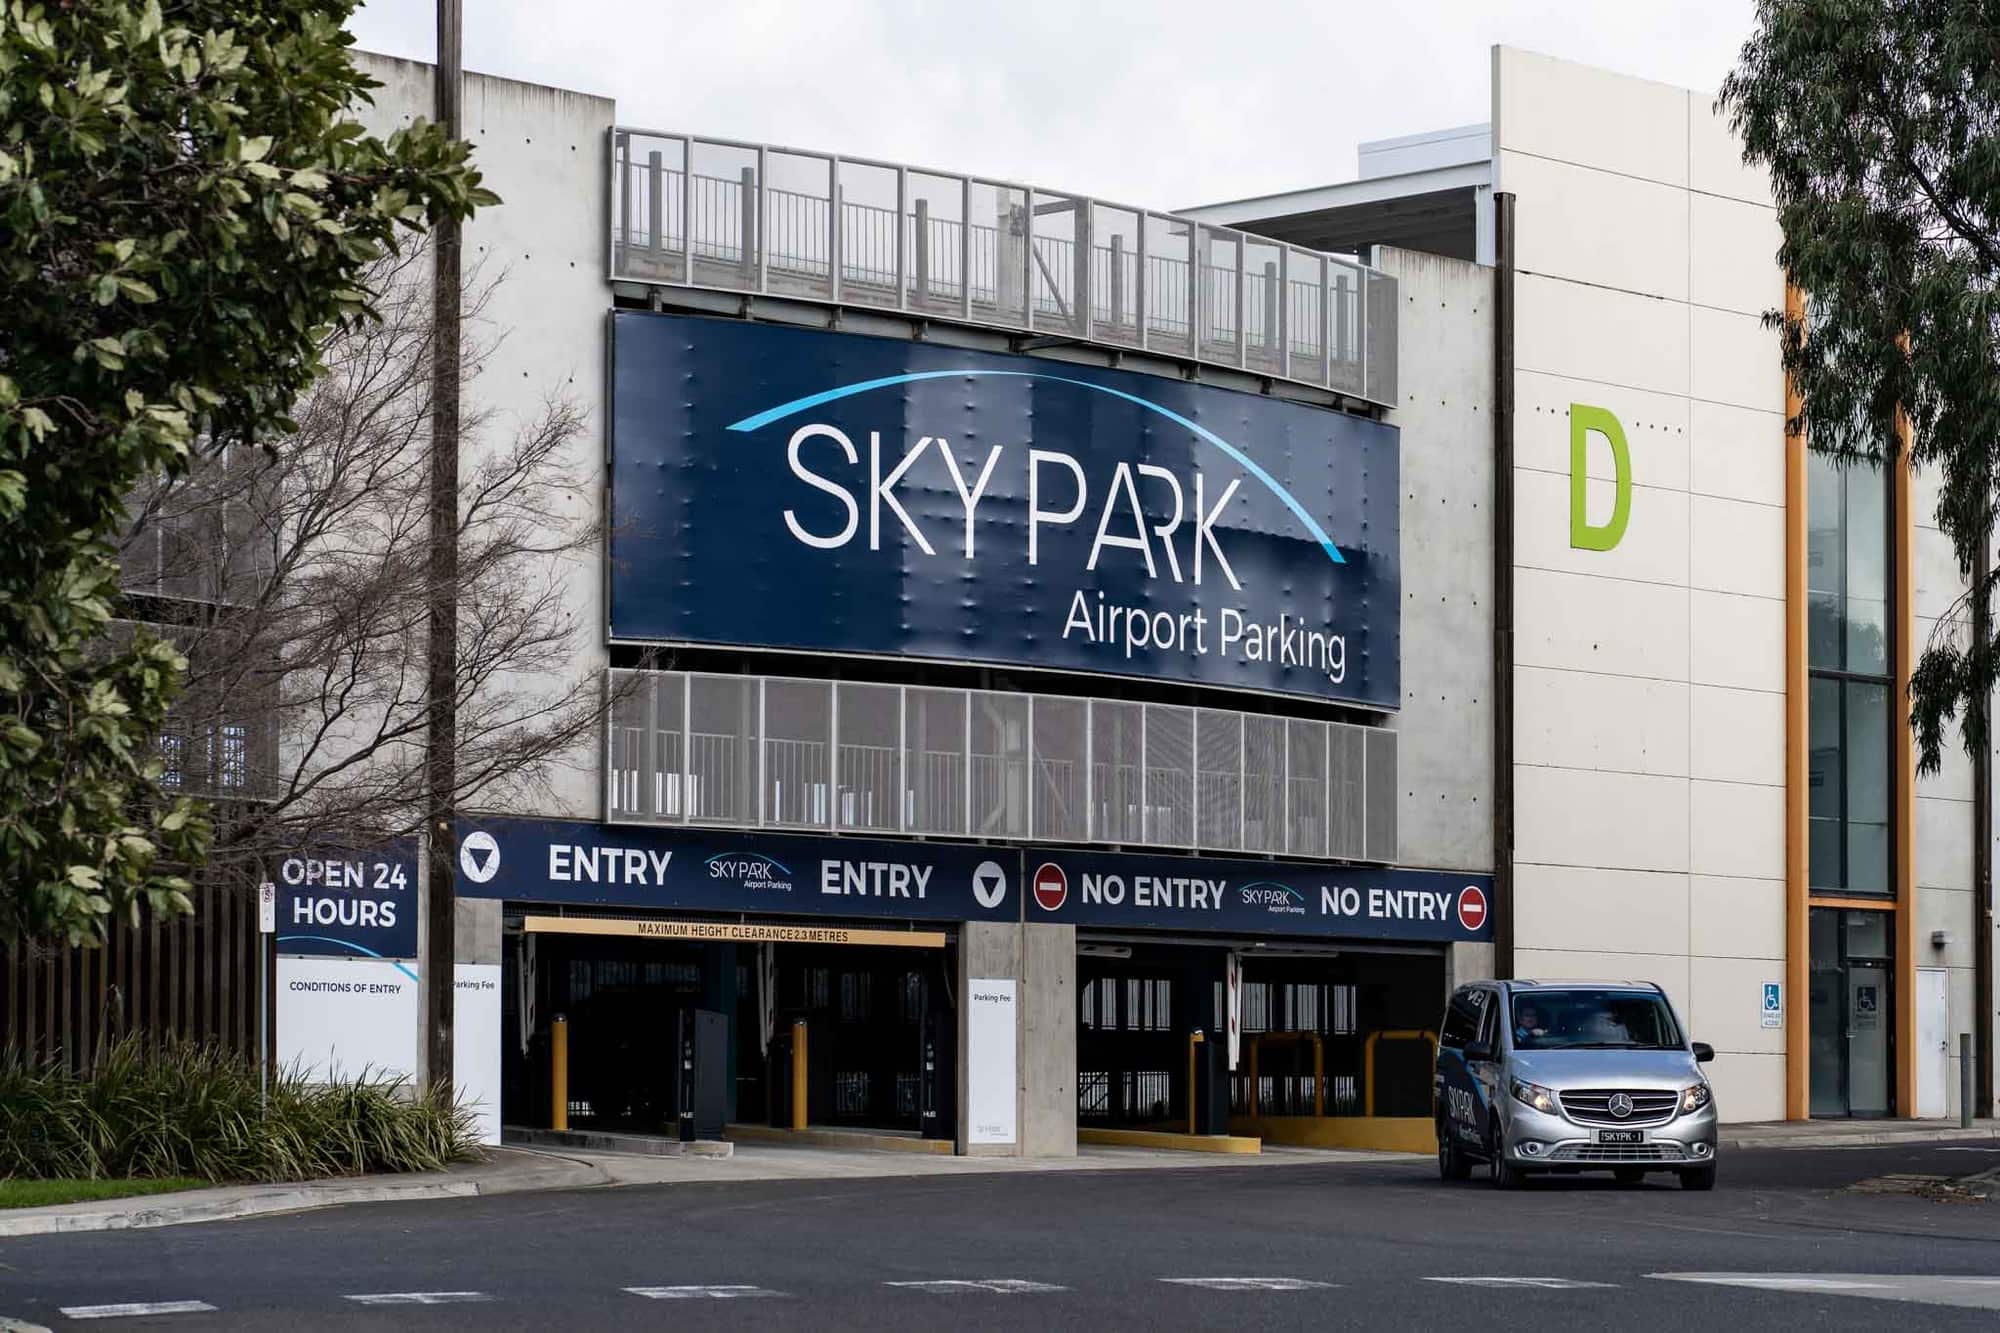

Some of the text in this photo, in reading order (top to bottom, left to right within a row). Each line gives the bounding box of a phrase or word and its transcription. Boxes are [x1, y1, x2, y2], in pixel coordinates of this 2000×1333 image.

[1570, 403, 1632, 552] D
[1062, 590, 1347, 685] Airport Parking
[282, 858, 407, 890] OPEN 24
[548, 844, 673, 887] ENTRY
[820, 859, 934, 899] ENTRY
[743, 880, 792, 892] Airport Parking
[1081, 873, 1227, 910] NO ENTRY
[293, 897, 396, 927] HOURS
[1320, 886, 1452, 922] NO ENTRY
[638, 923, 688, 936] MAXIMUM
[691, 926, 728, 938] HEIGHT
[731, 928, 793, 940] CLEARANCE
[808, 930, 849, 942] METRES
[289, 981, 401, 995] CONDITIONS OF ENTRY
[481, 980, 495, 989] Fee
[974, 993, 998, 1003] Parking
